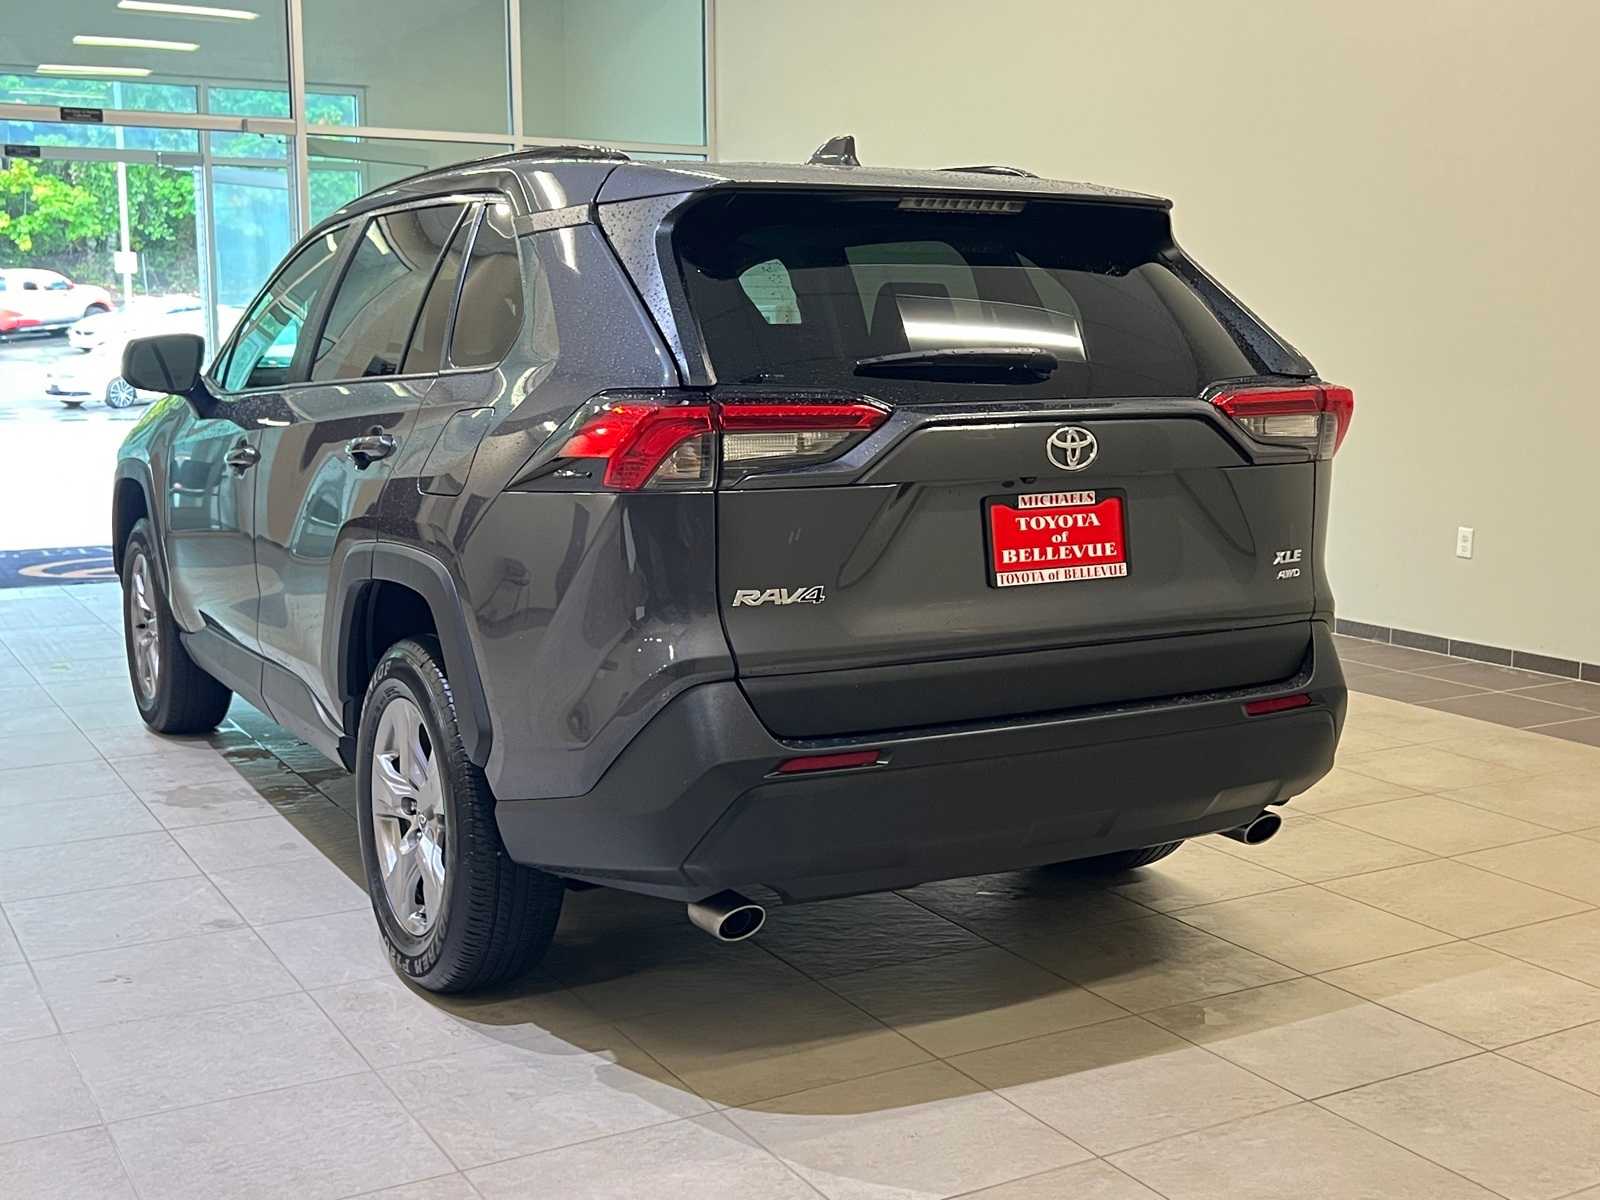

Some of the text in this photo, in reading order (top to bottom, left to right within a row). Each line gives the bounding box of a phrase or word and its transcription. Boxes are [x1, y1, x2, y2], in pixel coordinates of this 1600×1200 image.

[1020, 492, 1094, 506] MICHAELS
[1015, 512, 1101, 531] TOYOTA
[1051, 531, 1069, 543] of
[1001, 542, 1117, 564] BELLEVUE
[1273, 549, 1302, 565] XLE
[999, 564, 1126, 585] TOYOTA of BELLEVUE
[1276, 568, 1300, 580] AWD
[732, 585, 826, 607] RAV4
